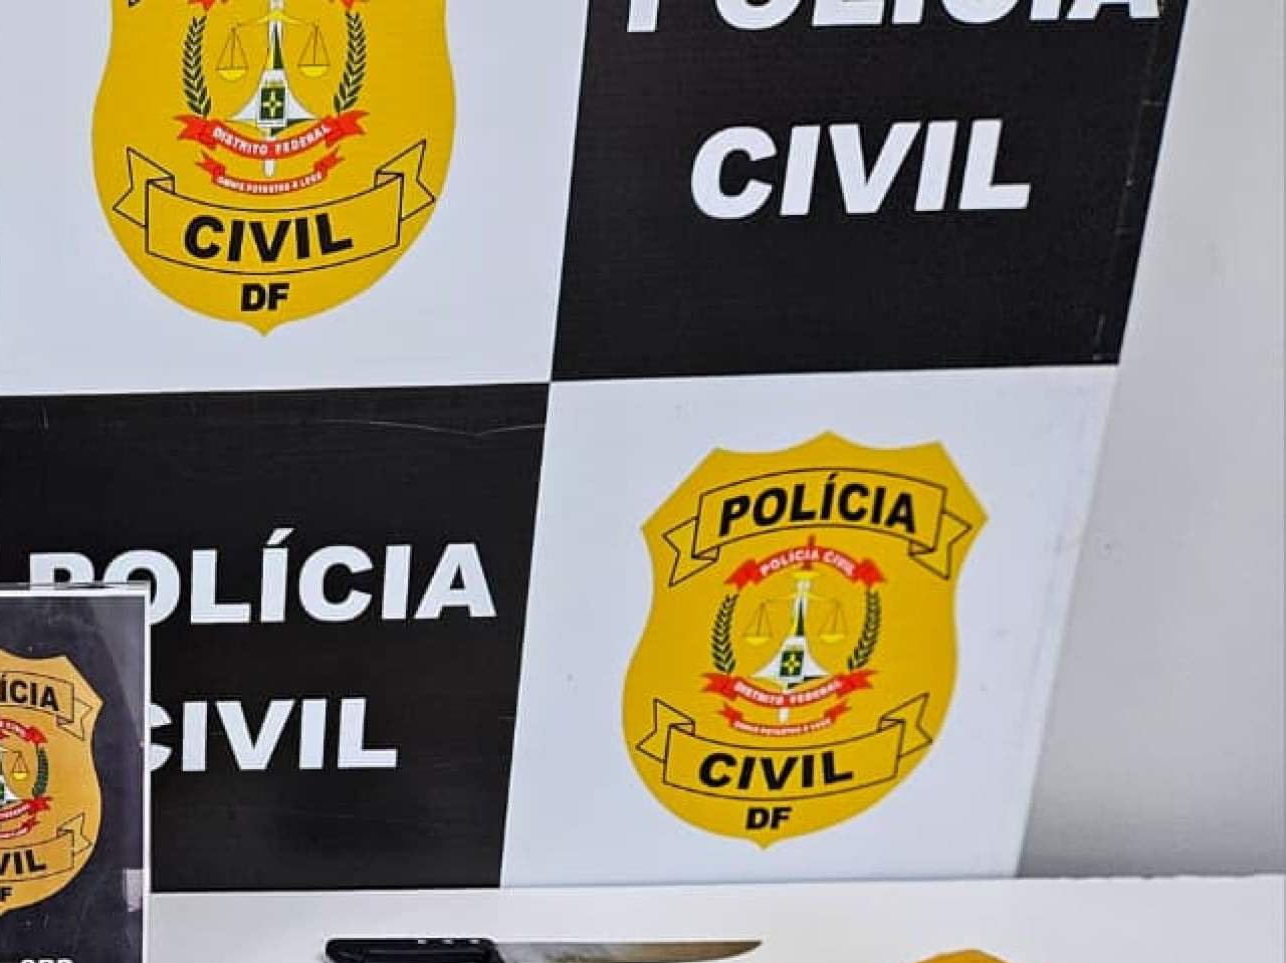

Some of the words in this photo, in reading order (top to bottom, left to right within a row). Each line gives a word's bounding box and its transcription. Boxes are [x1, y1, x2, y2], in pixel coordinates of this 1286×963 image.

[690, 119, 1031, 220] CIVIL
[183, 213, 354, 263] CIVIL
[240, 283, 290, 312] DF
[718, 473, 916, 537] POLÍCIA
[150, 697, 398, 772] IVIL
[698, 751, 853, 791] CIVIL
[745, 806, 792, 830] DF
